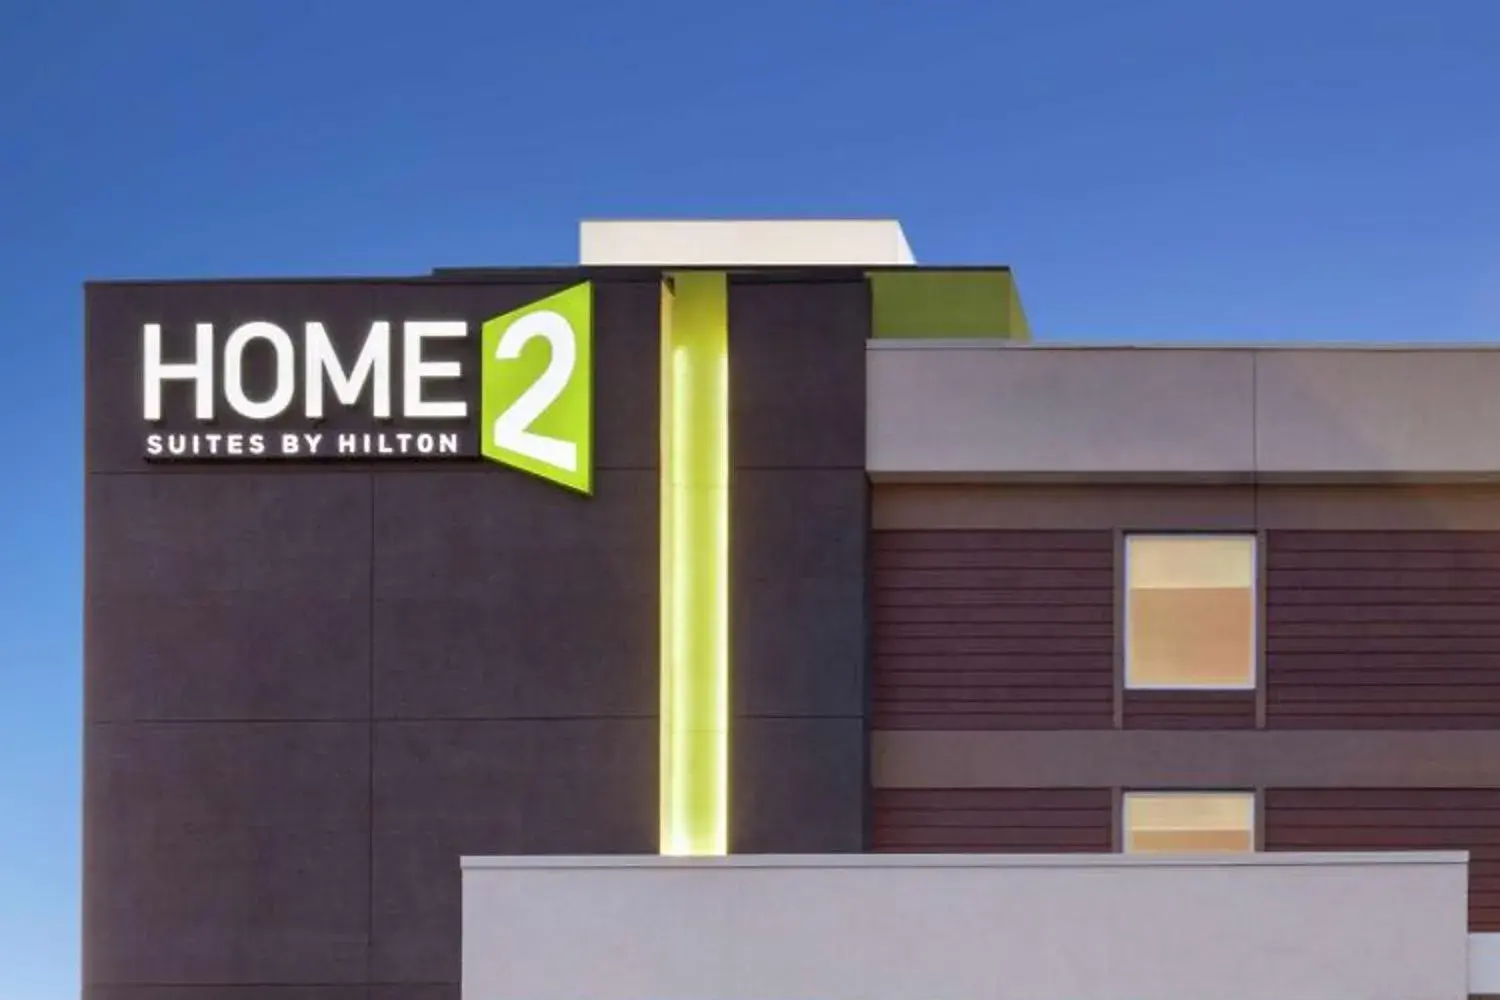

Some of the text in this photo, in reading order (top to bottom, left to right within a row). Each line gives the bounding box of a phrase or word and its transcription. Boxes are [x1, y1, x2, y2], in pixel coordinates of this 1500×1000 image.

[143, 310, 577, 472] HOME 2
[146, 433, 459, 455] SUITES BY HILTON
